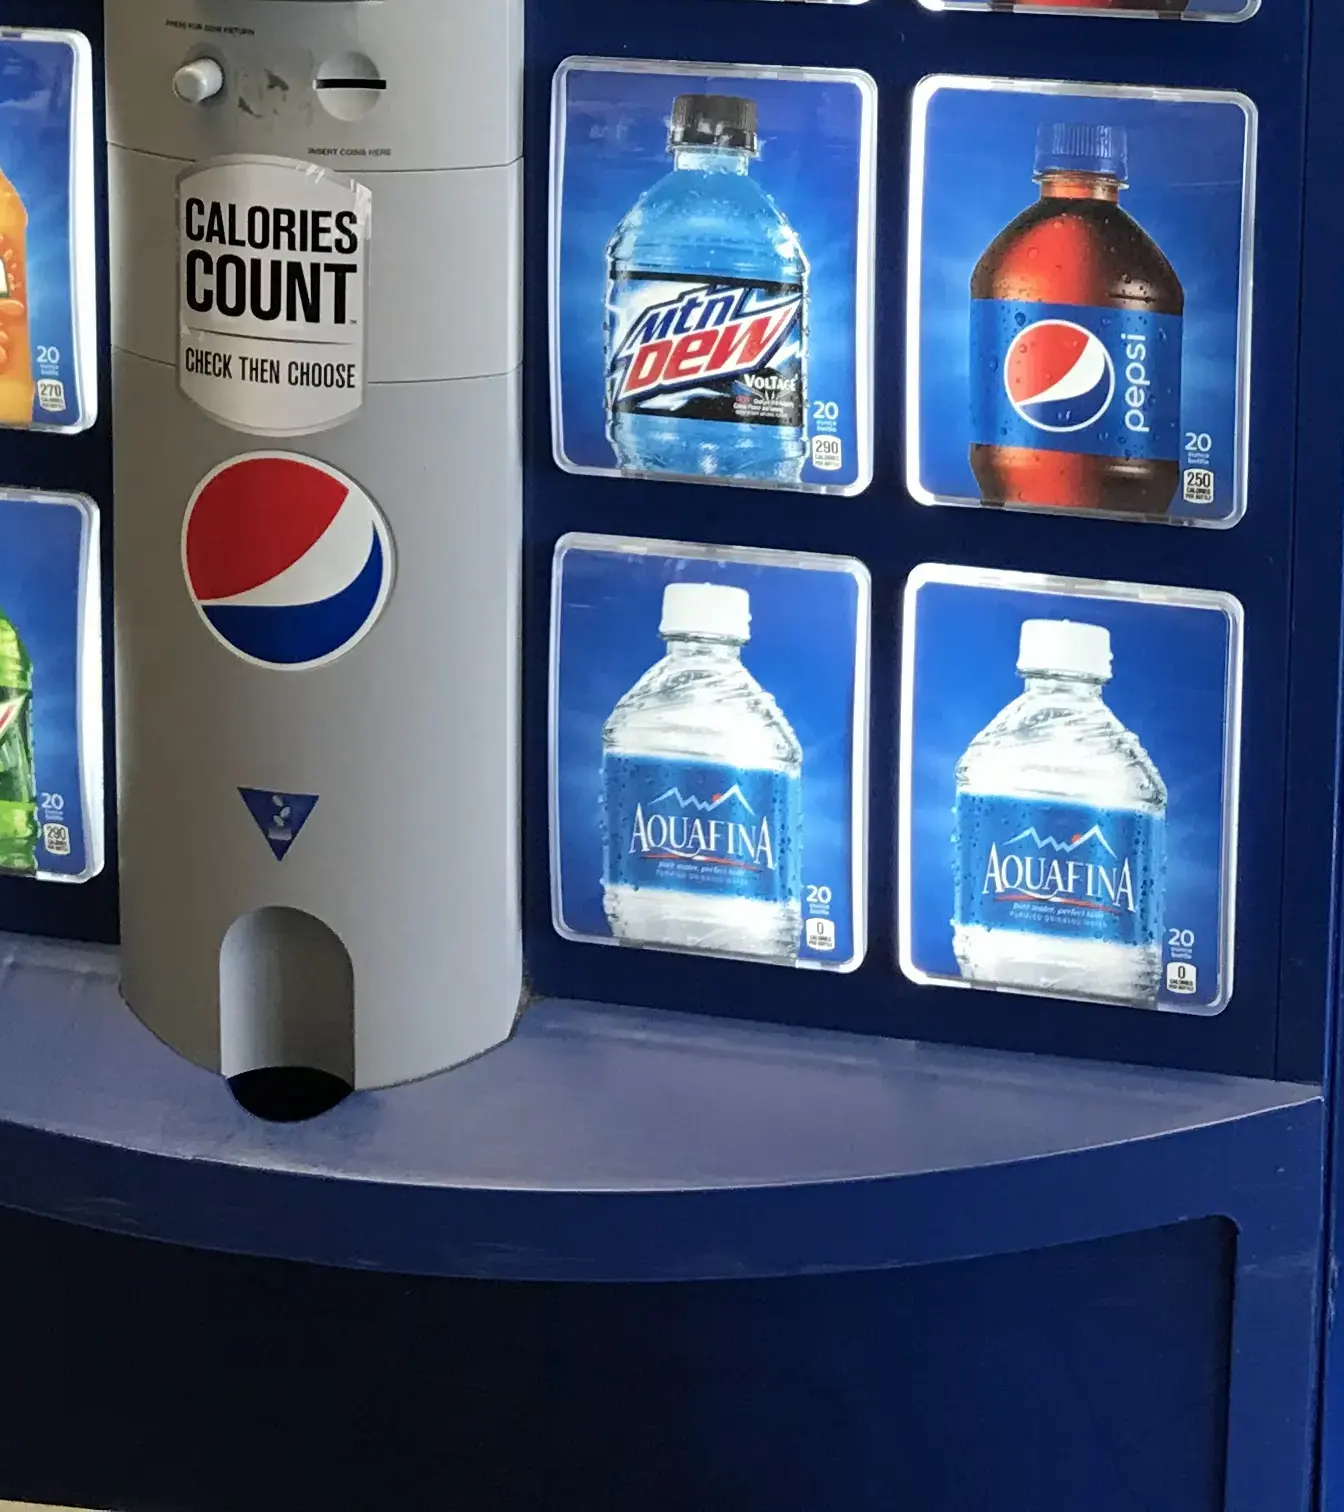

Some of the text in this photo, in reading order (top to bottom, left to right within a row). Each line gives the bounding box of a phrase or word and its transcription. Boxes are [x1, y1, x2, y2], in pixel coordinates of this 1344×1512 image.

[308, 148, 337, 156] INSERT
[185, 197, 358, 254] CALORIES
[186, 249, 357, 325] COUNT
[37, 348, 59, 364] 20
[185, 347, 355, 389] CHECK THEN CHOOSE
[41, 383, 61, 397] 270
[1121, 333, 1149, 432] pepsi
[813, 401, 839, 419] 20
[815, 440, 838, 454] 290
[1185, 432, 1212, 451] 20
[1187, 472, 1210, 488] 250
[42, 793, 63, 809] 20
[47, 826, 66, 838] 290
[629, 802, 776, 870] AQUAFINA
[982, 842, 1136, 913] AQUAFINA
[806, 886, 831, 903] 20
[817, 922, 824, 934] 0
[1168, 929, 1194, 946] 20
[1178, 966, 1184, 979] 0
